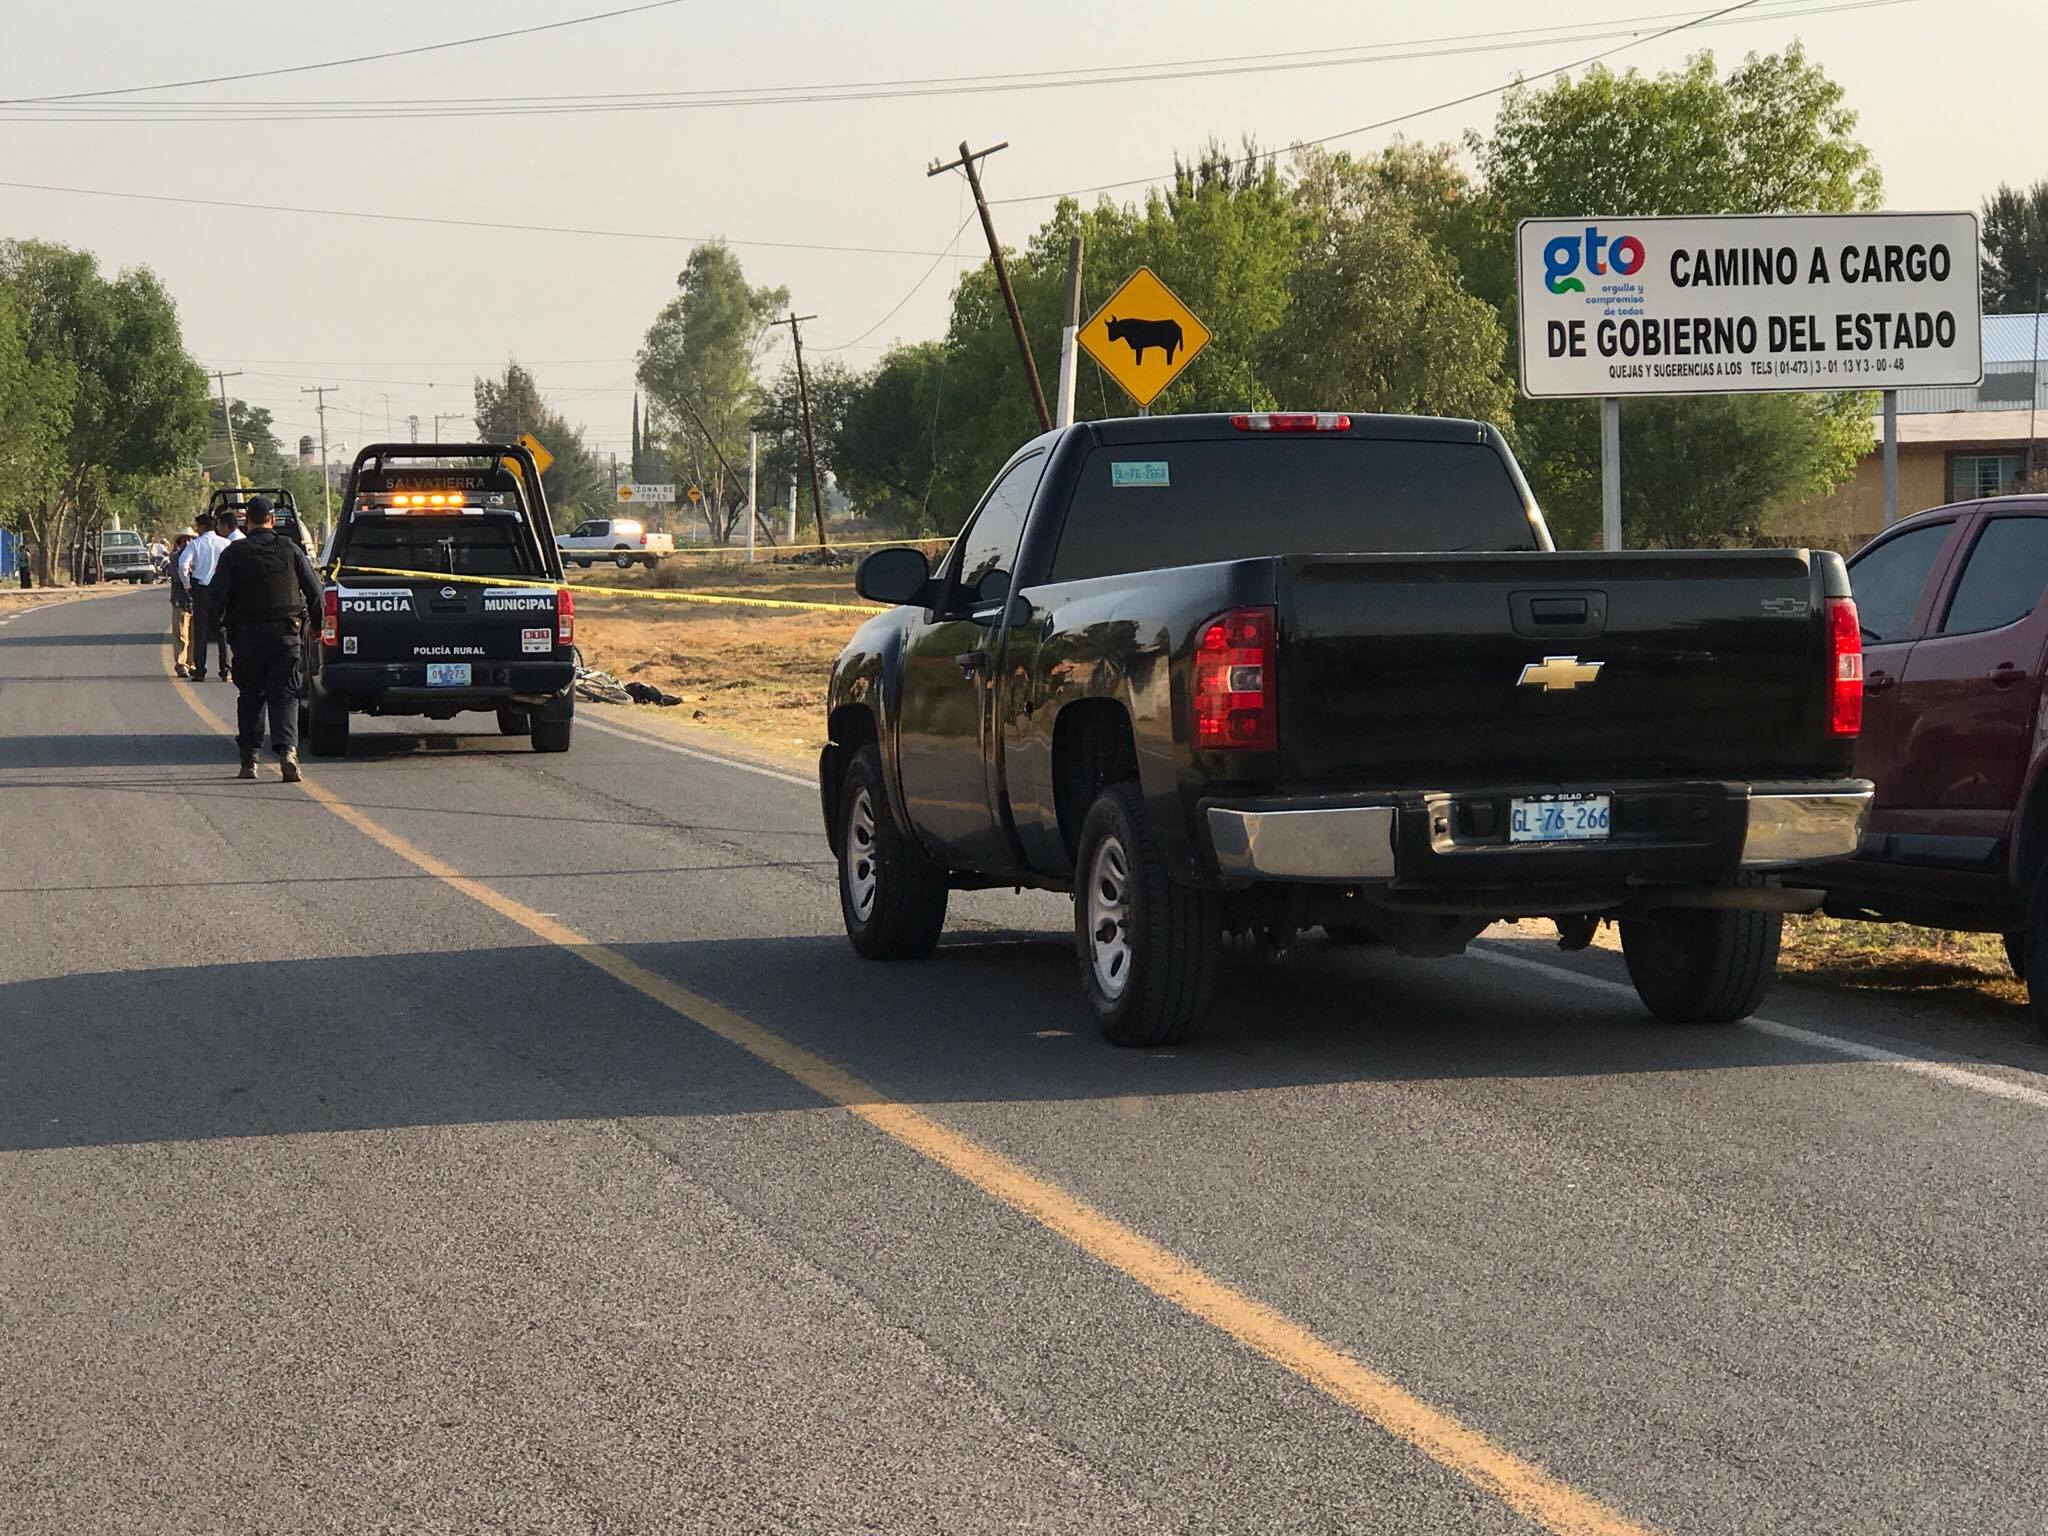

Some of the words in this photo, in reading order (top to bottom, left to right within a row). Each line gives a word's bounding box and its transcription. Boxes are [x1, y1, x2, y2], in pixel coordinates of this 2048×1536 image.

[1543, 226, 1646, 295] gto
[1670, 246, 1798, 287] CAMINO
[1808, 246, 1831, 285] A
[1839, 243, 1952, 284] CARGO
[1601, 283, 1635, 294] orgullo
[1637, 285, 1644, 294] y
[1585, 295, 1645, 305] compromiso
[1604, 307, 1615, 315] de
[1618, 307, 1644, 315] todos
[1547, 320, 1587, 358] DE
[1596, 315, 1758, 359] GOBIERNO
[1768, 314, 1826, 353] DEL
[1835, 310, 1957, 352] ESTADO
[1609, 364, 1643, 379] QUEJAS
[1645, 364, 1652, 377] Y
[1653, 362, 1715, 377] SUGERENCIAS
[1716, 362, 1723, 375] A
[1725, 361, 1742, 375] LOS
[1751, 361, 1772, 374] TELS
[1854, 358, 1862, 372] Y
[385, 477, 486, 489] SALVATIERRA
[341, 596, 411, 612] POLICÍA
[484, 598, 554, 611] MUNICIPAL
[413, 645, 451, 655] POLICÍA
[453, 646, 485, 655] RURAL
